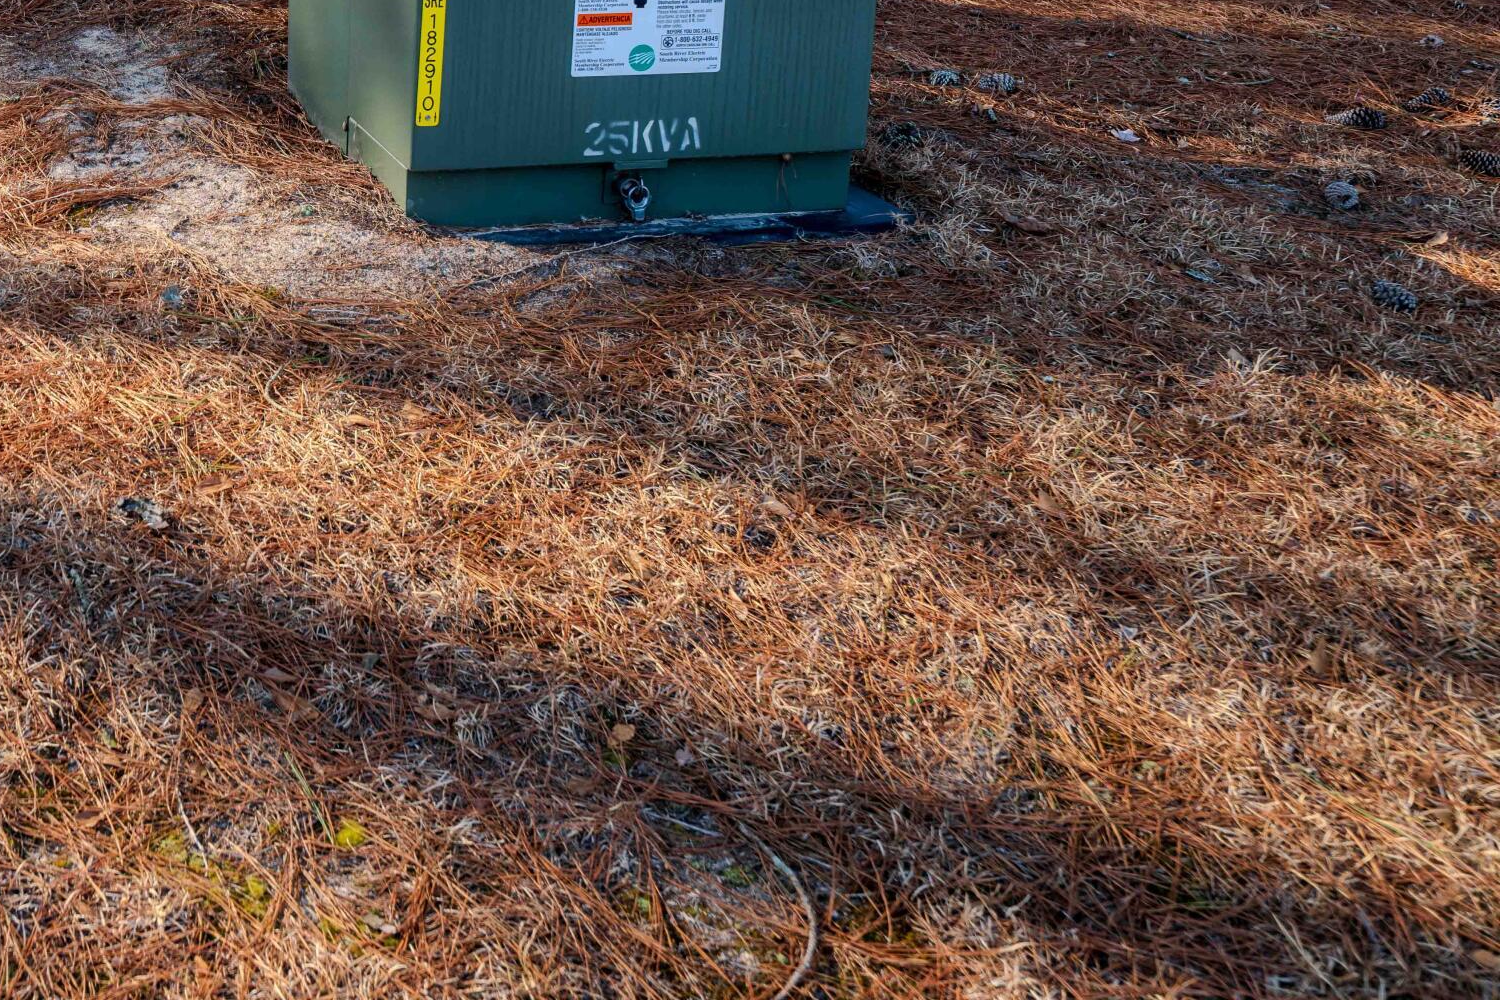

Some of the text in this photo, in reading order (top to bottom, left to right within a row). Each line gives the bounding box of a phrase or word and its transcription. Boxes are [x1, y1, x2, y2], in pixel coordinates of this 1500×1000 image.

[589, 15, 631, 23] ADVERTENCIA
[422, 13, 437, 111] 182910
[583, 117, 702, 157] 25KVA
